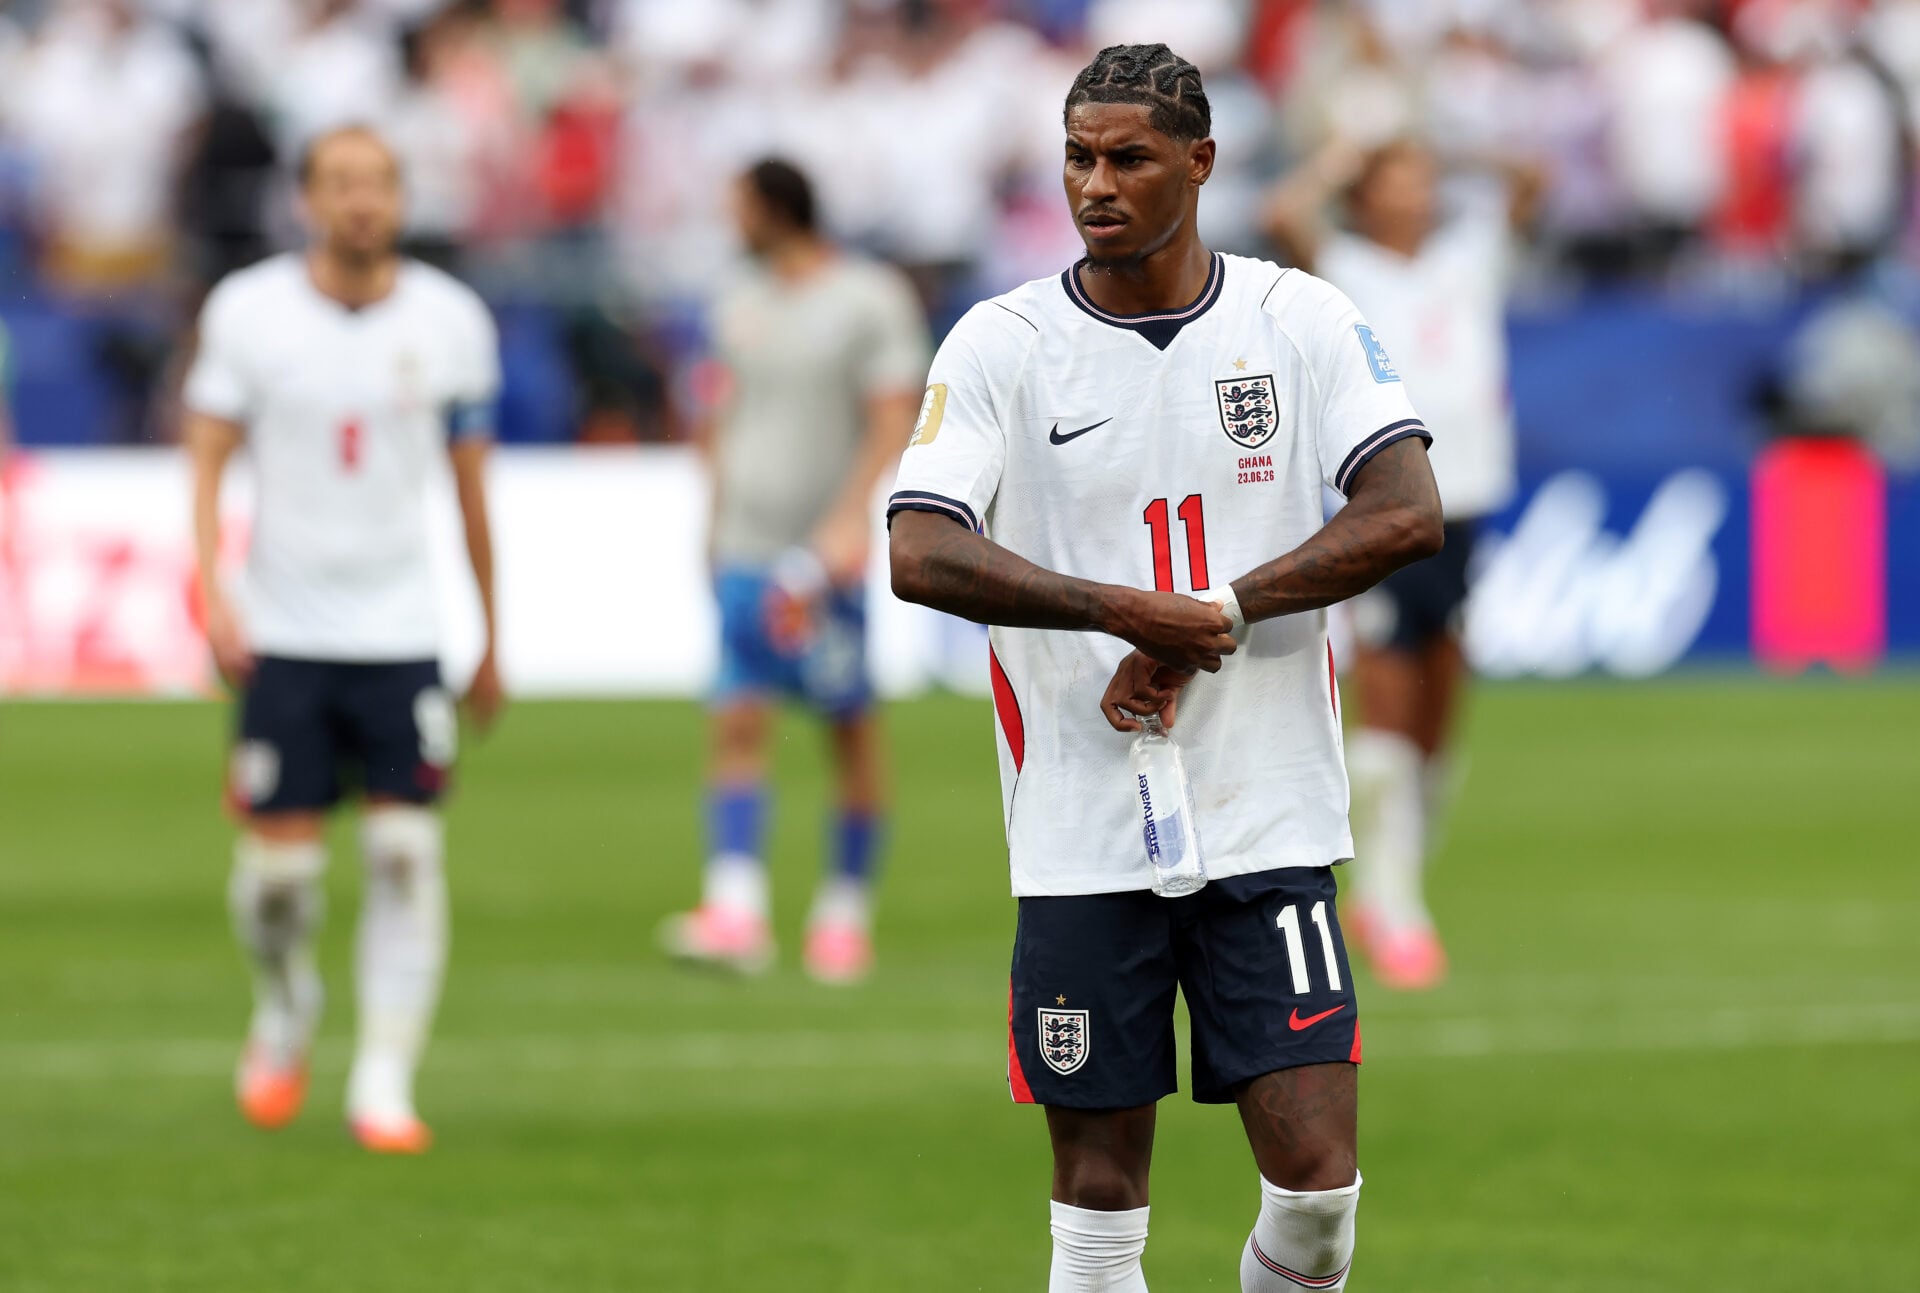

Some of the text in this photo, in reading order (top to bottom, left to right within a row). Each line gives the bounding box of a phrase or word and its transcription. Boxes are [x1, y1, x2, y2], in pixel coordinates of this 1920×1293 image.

[1237, 469, 1274, 484] 23.06.26
[1238, 455, 1273, 469] GHANA
[1143, 493, 1210, 593] 11
[1138, 773, 1160, 856] smartwater
[1275, 900, 1342, 994] 11
